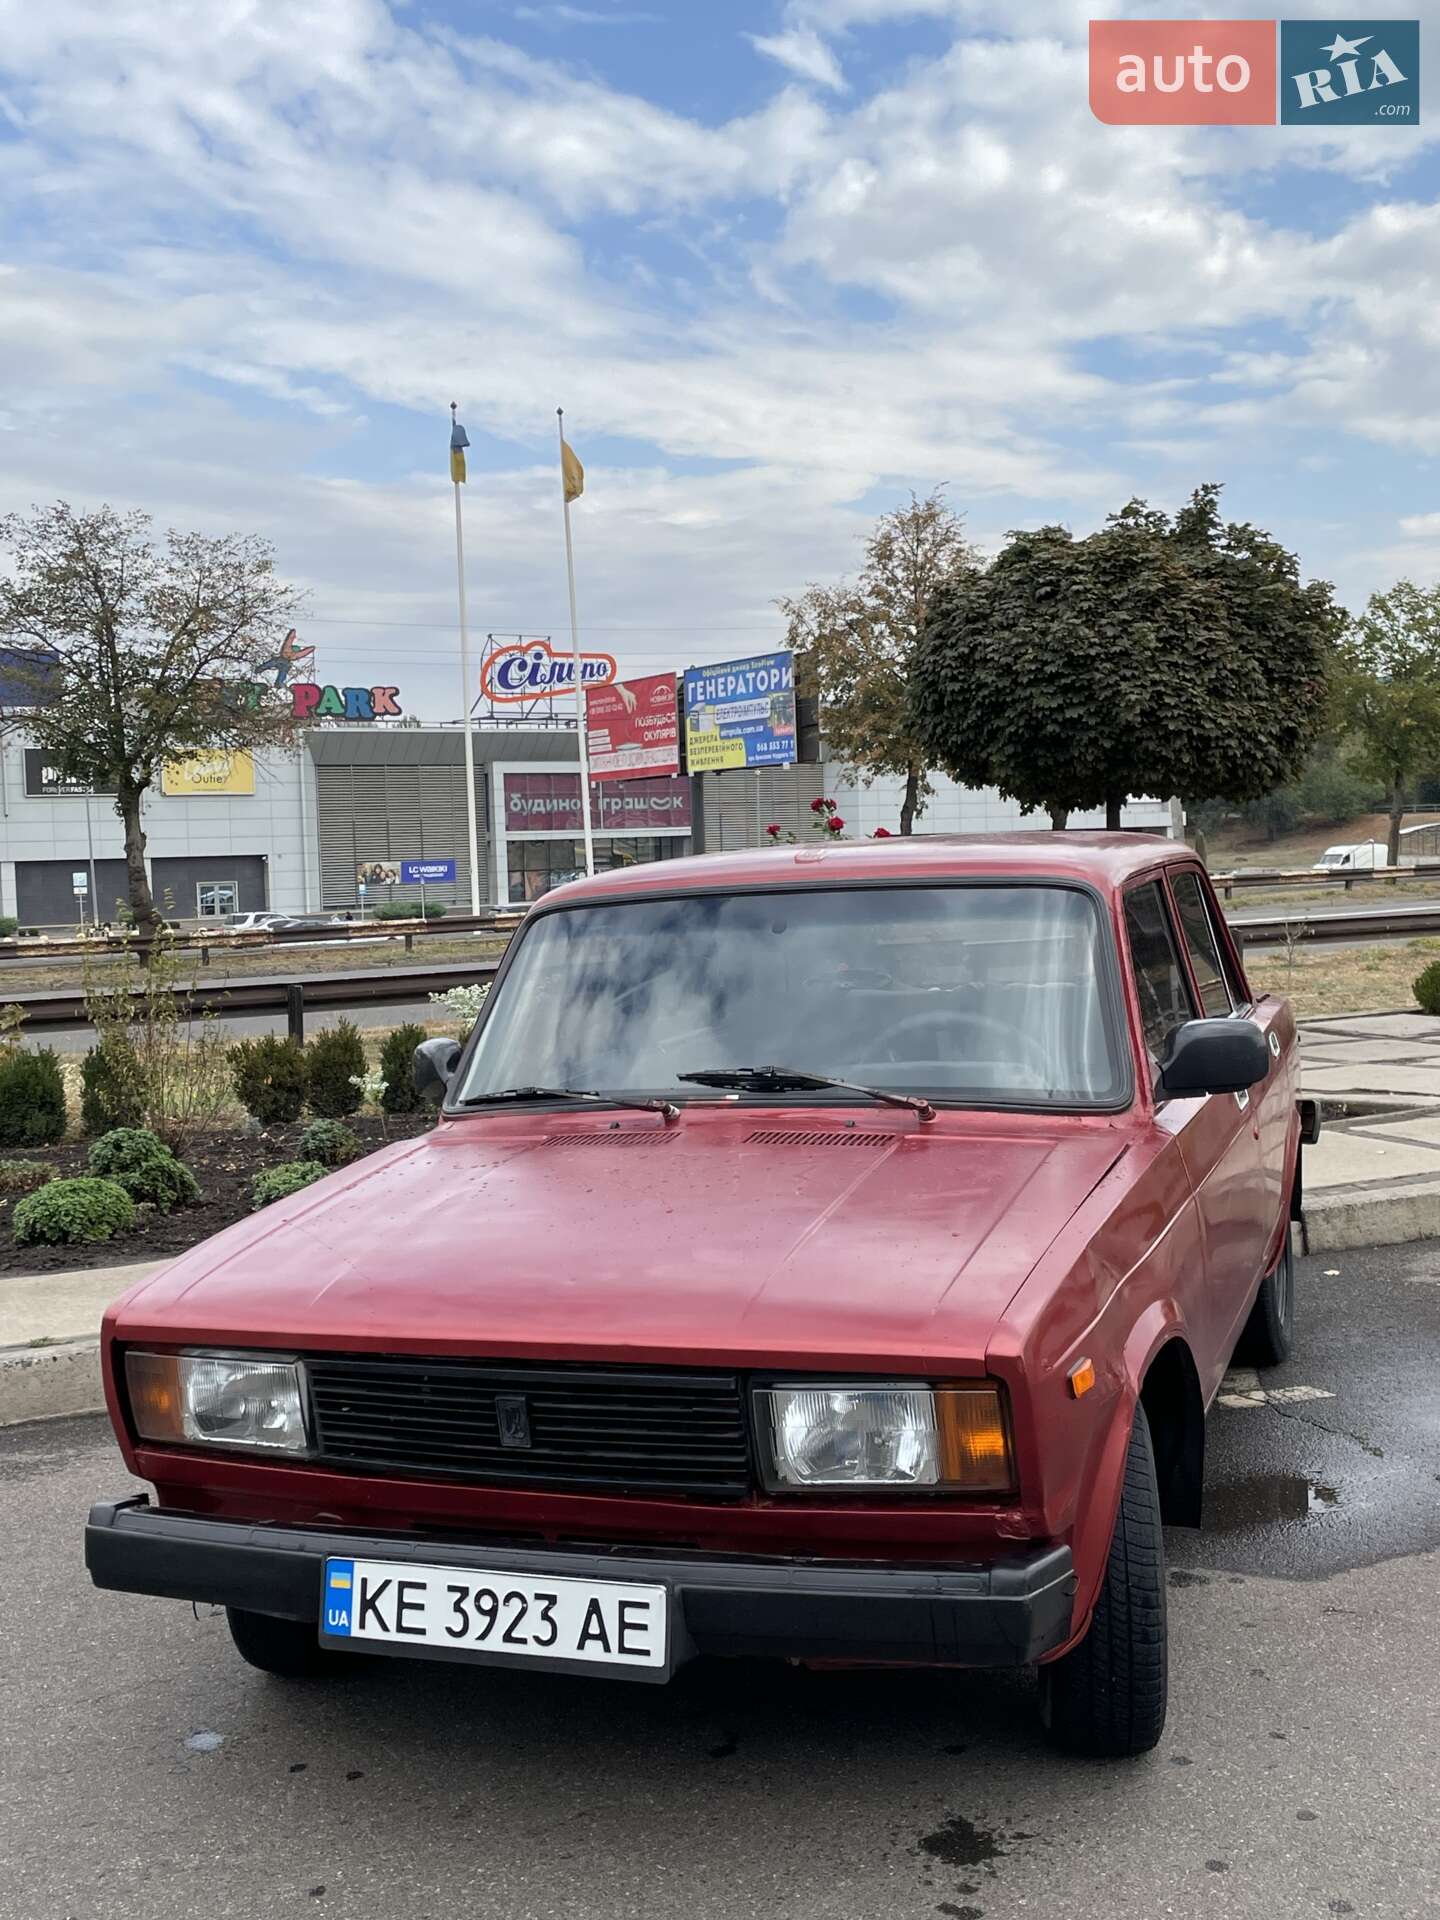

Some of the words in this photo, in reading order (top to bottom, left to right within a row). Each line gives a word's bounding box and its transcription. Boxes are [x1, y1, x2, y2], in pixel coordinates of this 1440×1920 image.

[688, 666, 793, 703] ГЕНЕРАТОРИ
[291, 683, 402, 720] PARK
[510, 793, 592, 816] будино
[408, 866, 419, 874] LC
[328, 1608, 349, 1627] UA
[358, 1576, 427, 1636] KE
[444, 1584, 558, 1647] 3923
[576, 1597, 651, 1657] AE
